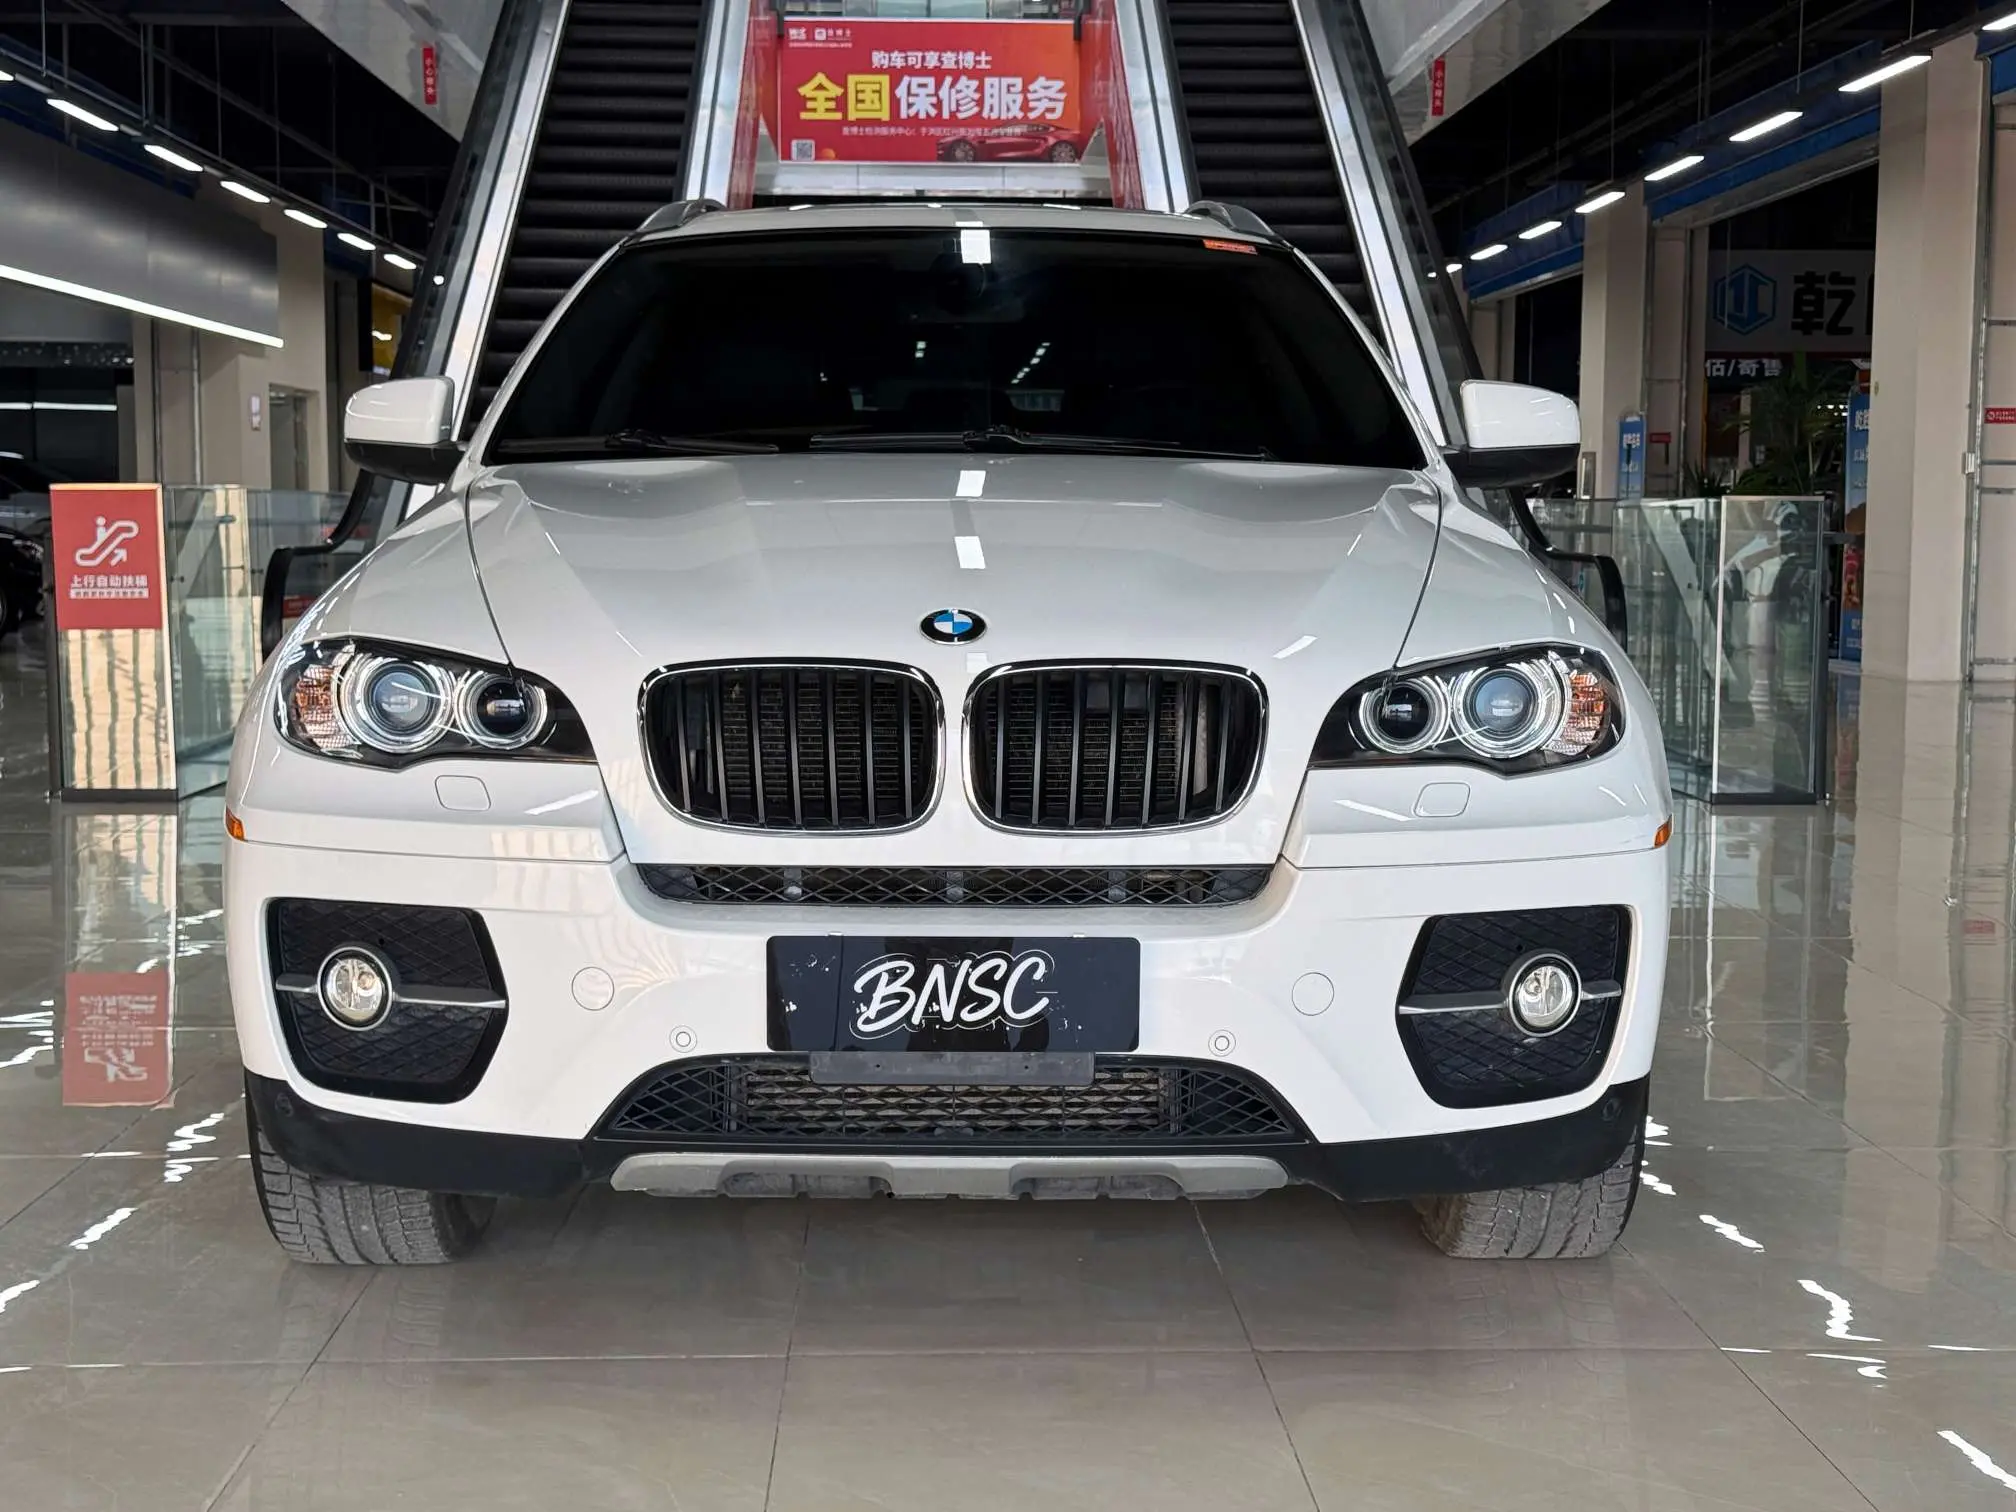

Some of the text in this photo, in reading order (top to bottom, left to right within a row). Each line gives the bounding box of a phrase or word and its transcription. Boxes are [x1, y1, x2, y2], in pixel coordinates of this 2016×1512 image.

[871, 51, 992, 69] 购车可享查博士
[798, 72, 1067, 121] 全国保修服务
[1791, 270, 1875, 335] 乾
[70, 574, 148, 588] 上行自动扶梯
